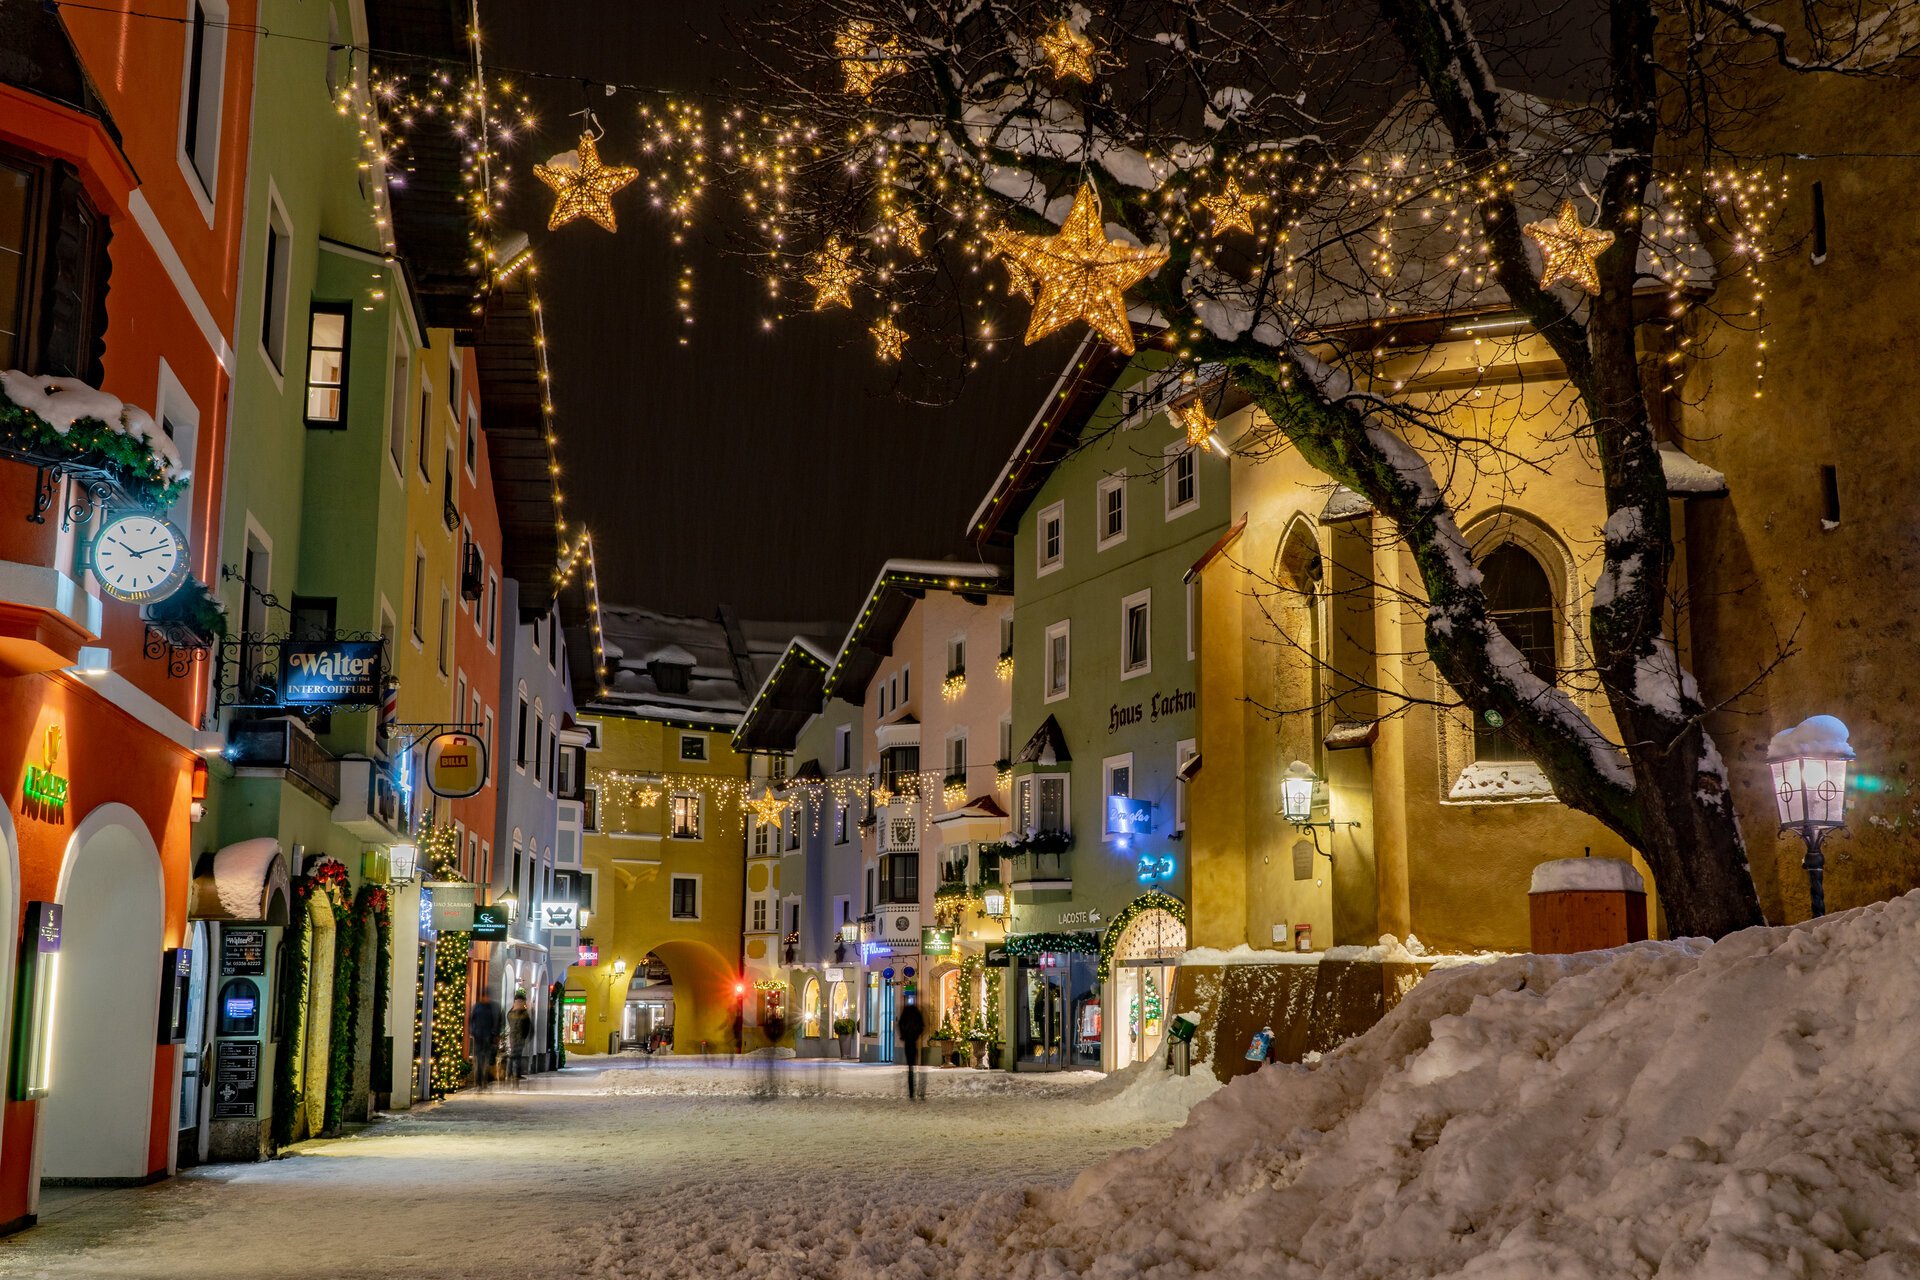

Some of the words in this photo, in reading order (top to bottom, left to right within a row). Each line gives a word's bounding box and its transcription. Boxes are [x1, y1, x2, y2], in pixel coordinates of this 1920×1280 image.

[289, 651, 376, 681] Walter
[288, 685, 374, 694] INTERCOIFFURE
[1108, 703, 1143, 735] Haus
[441, 757, 467, 766] BILLA
[26, 764, 69, 805] ROLEX
[1111, 807, 1150, 825] Douglas
[1058, 911, 1087, 925] LACOSTE
